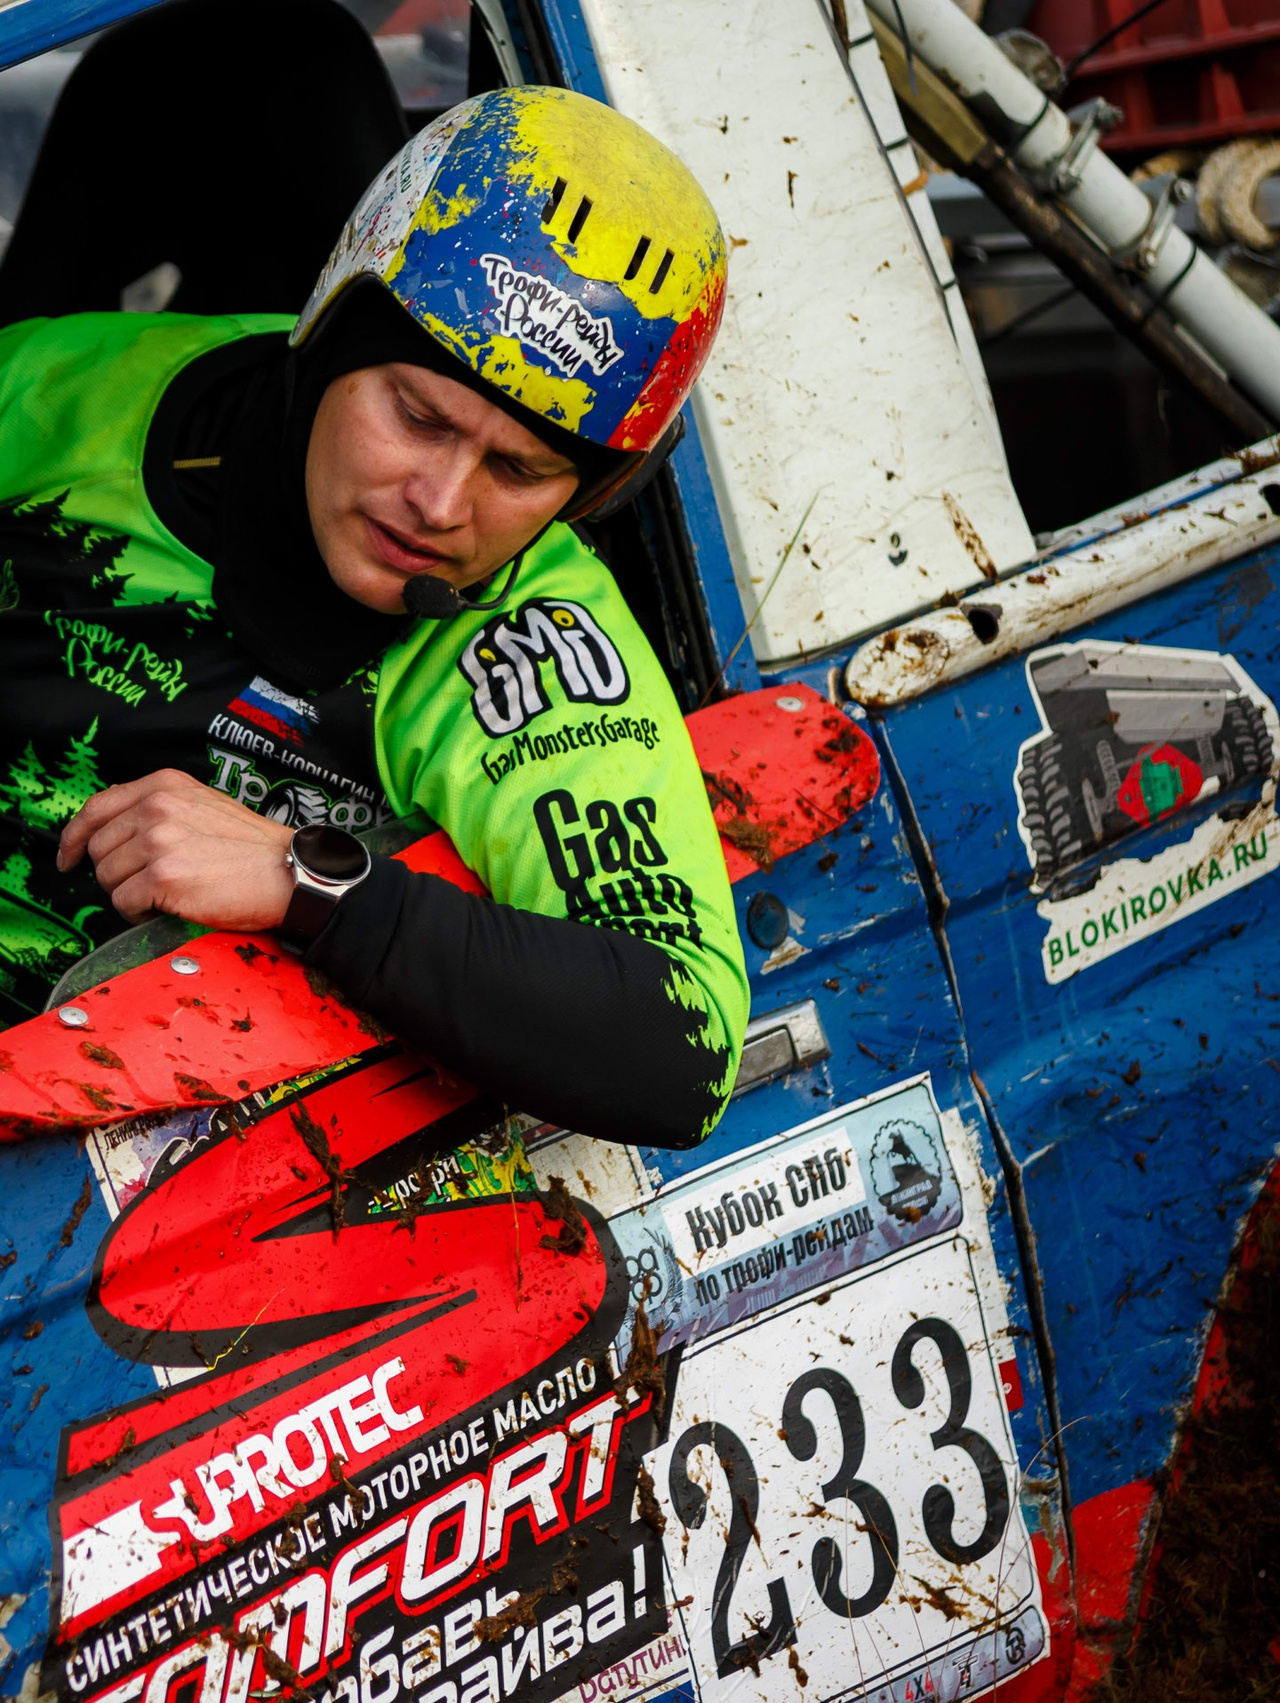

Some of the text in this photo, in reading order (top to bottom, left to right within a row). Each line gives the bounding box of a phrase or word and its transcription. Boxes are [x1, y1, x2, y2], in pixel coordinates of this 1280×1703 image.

[484, 256, 619, 370] Трофи-рейды
[499, 292, 583, 373] России
[60, 637, 147, 708] России
[481, 713, 661, 786] GasMonstersGarage
[532, 788, 669, 893] Gas
[1047, 831, 1269, 967] BLOKIROVKA.RU
[685, 1146, 848, 1255] Кубок СПб
[693, 1204, 876, 1308] по трофи-рейдам
[328, 1416, 490, 1538] МОТОРНОЕ
[492, 1357, 597, 1442] МАСЛО
[667, 1316, 1013, 1682] 233
[91, 1384, 644, 1703] OMFORT
